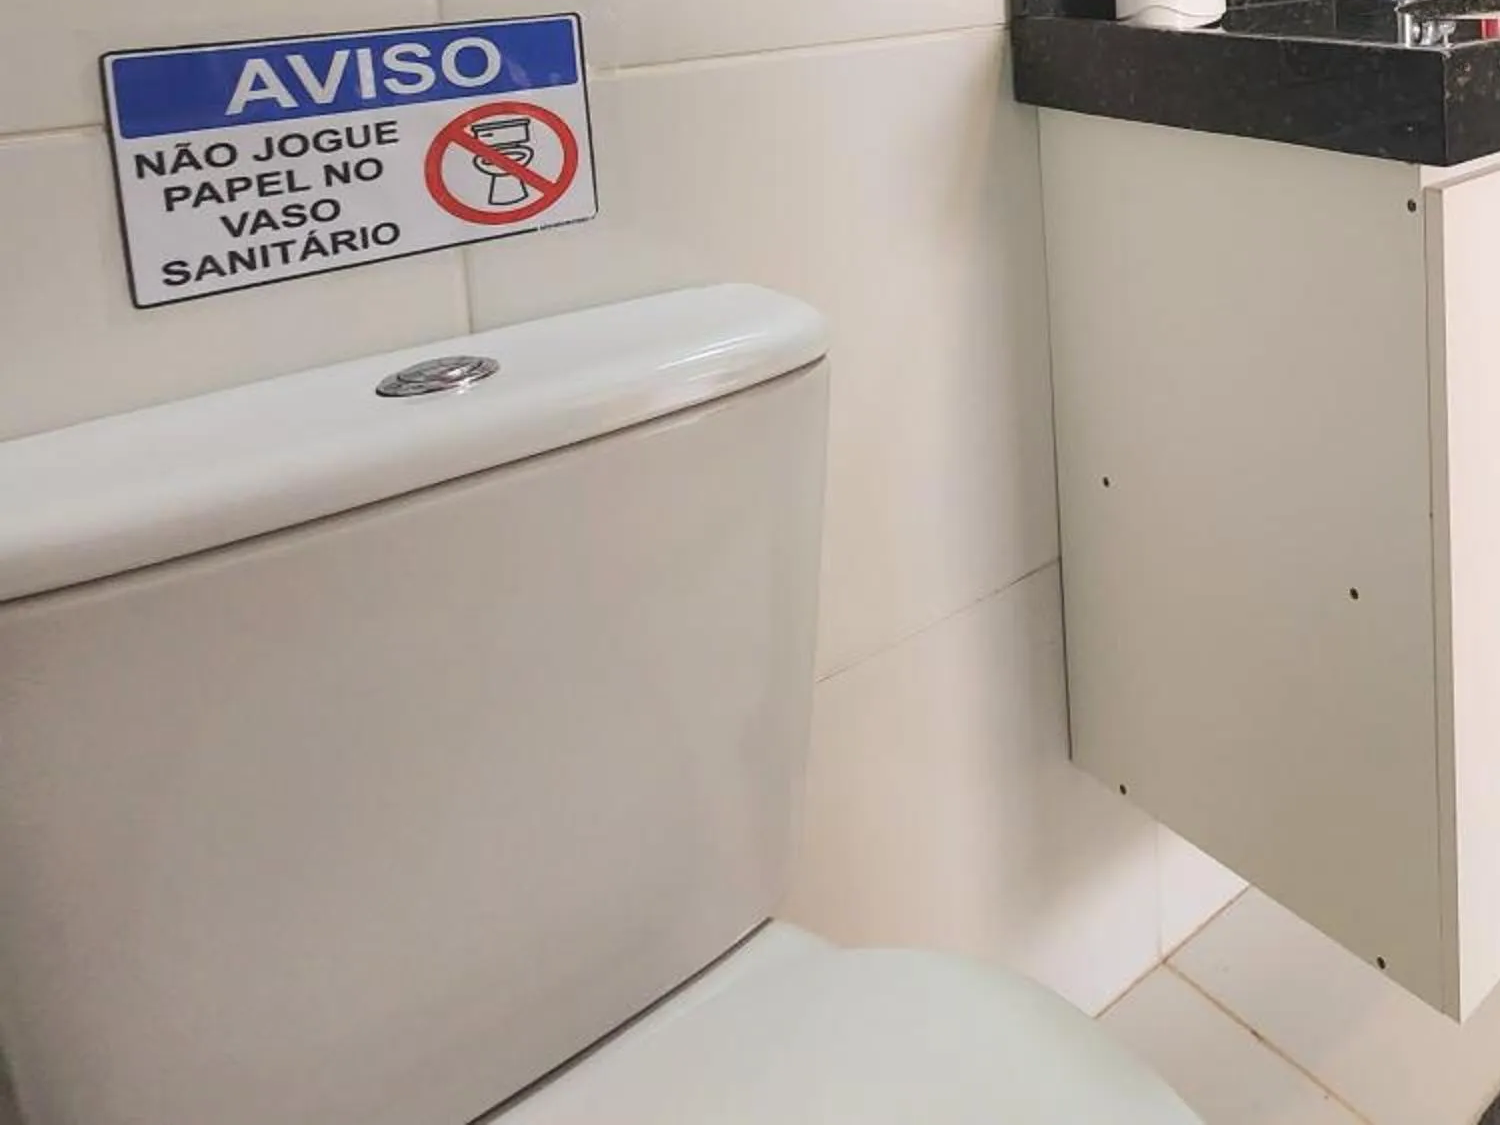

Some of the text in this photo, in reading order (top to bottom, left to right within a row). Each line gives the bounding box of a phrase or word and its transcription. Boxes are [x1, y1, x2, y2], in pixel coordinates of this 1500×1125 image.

[223, 36, 503, 117] AVISO
[134, 119, 400, 180] NÃO JOGUE
[164, 156, 384, 213] PAPEL NO
[219, 198, 341, 239] VASO
[161, 221, 401, 287] SANITÁRIO
